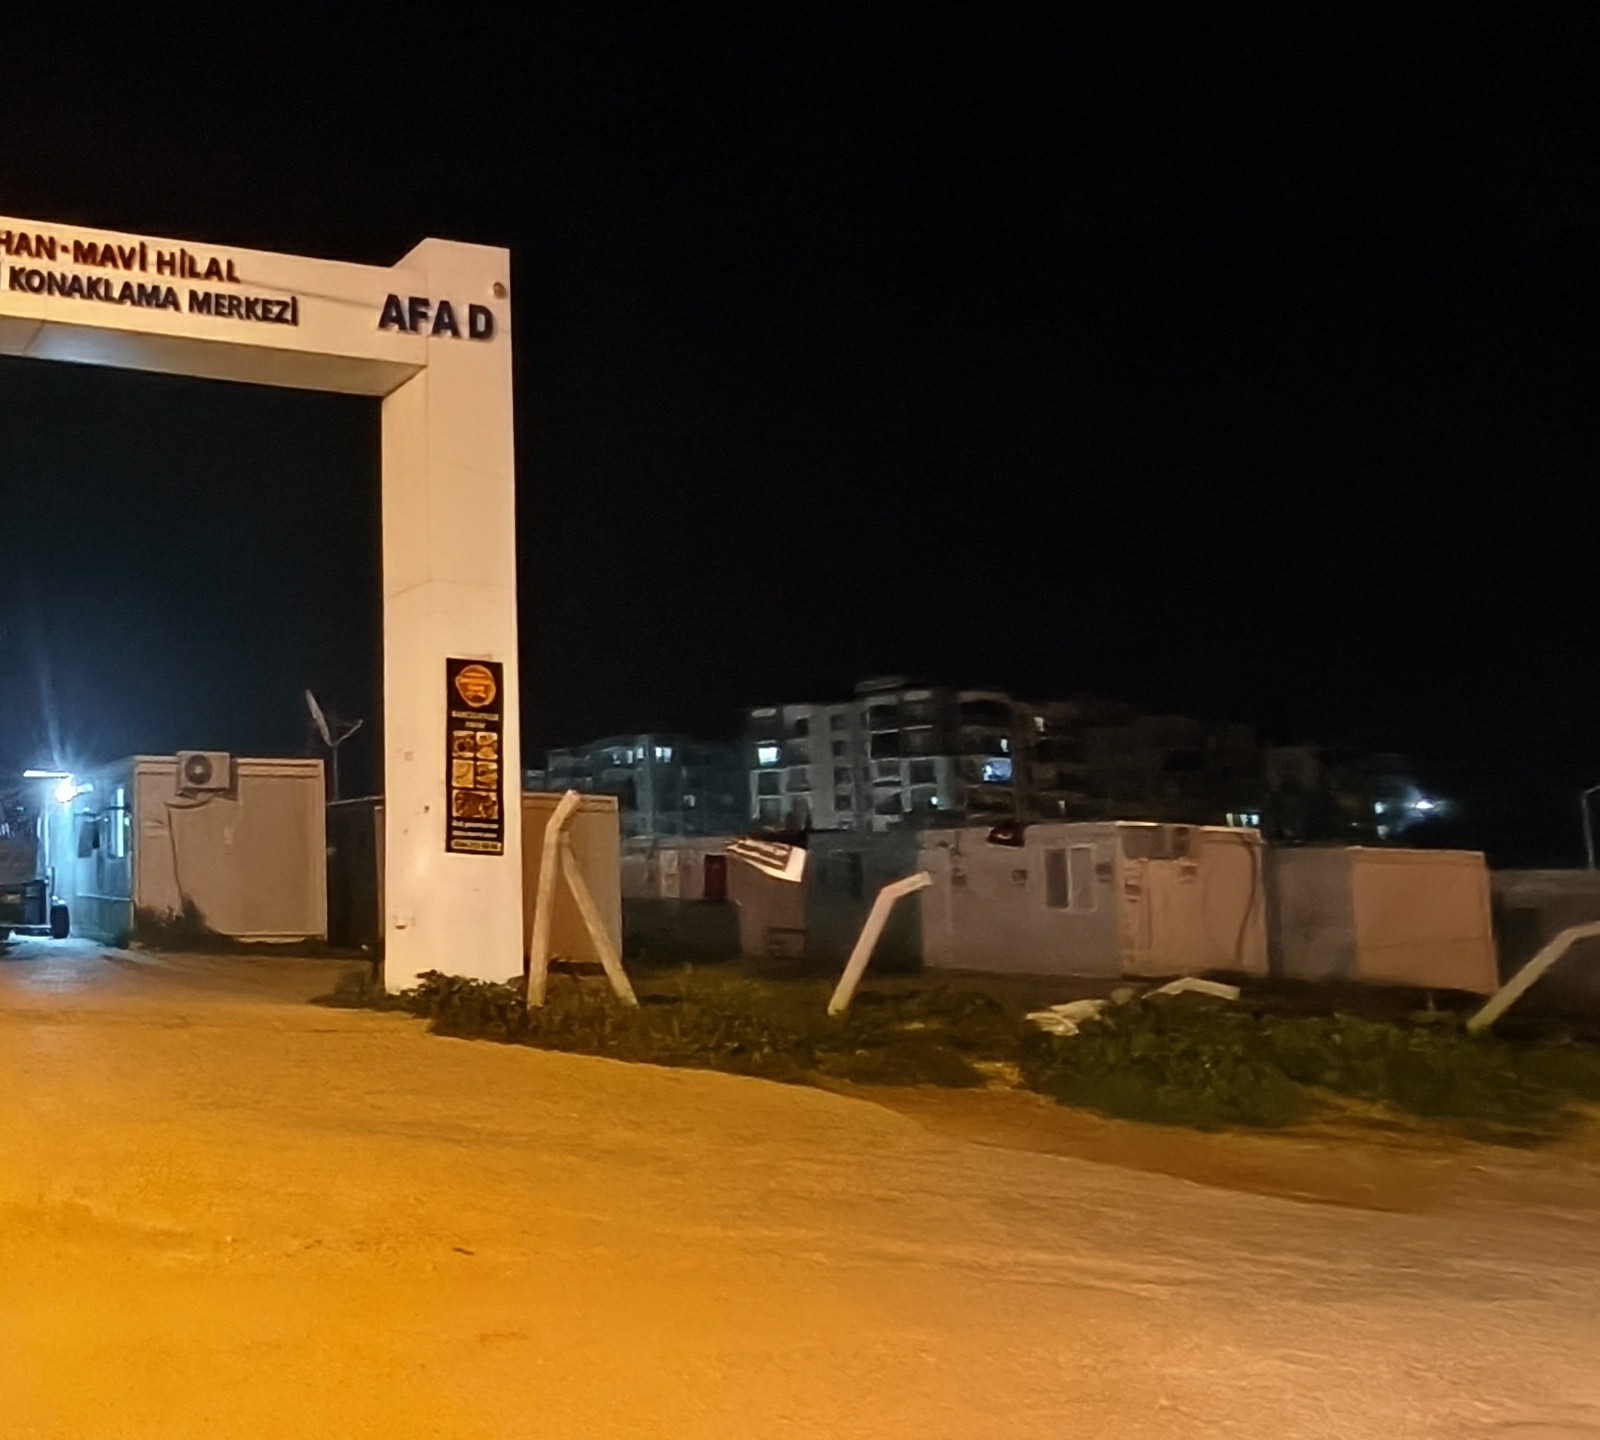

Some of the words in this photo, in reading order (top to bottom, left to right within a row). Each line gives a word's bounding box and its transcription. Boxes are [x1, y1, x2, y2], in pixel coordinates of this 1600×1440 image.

[156, 248, 241, 284] HİLAL
[8, 265, 182, 313] KONAKLAMA
[188, 289, 299, 327] MERKEZİ
[378, 293, 495, 342] AFAD
